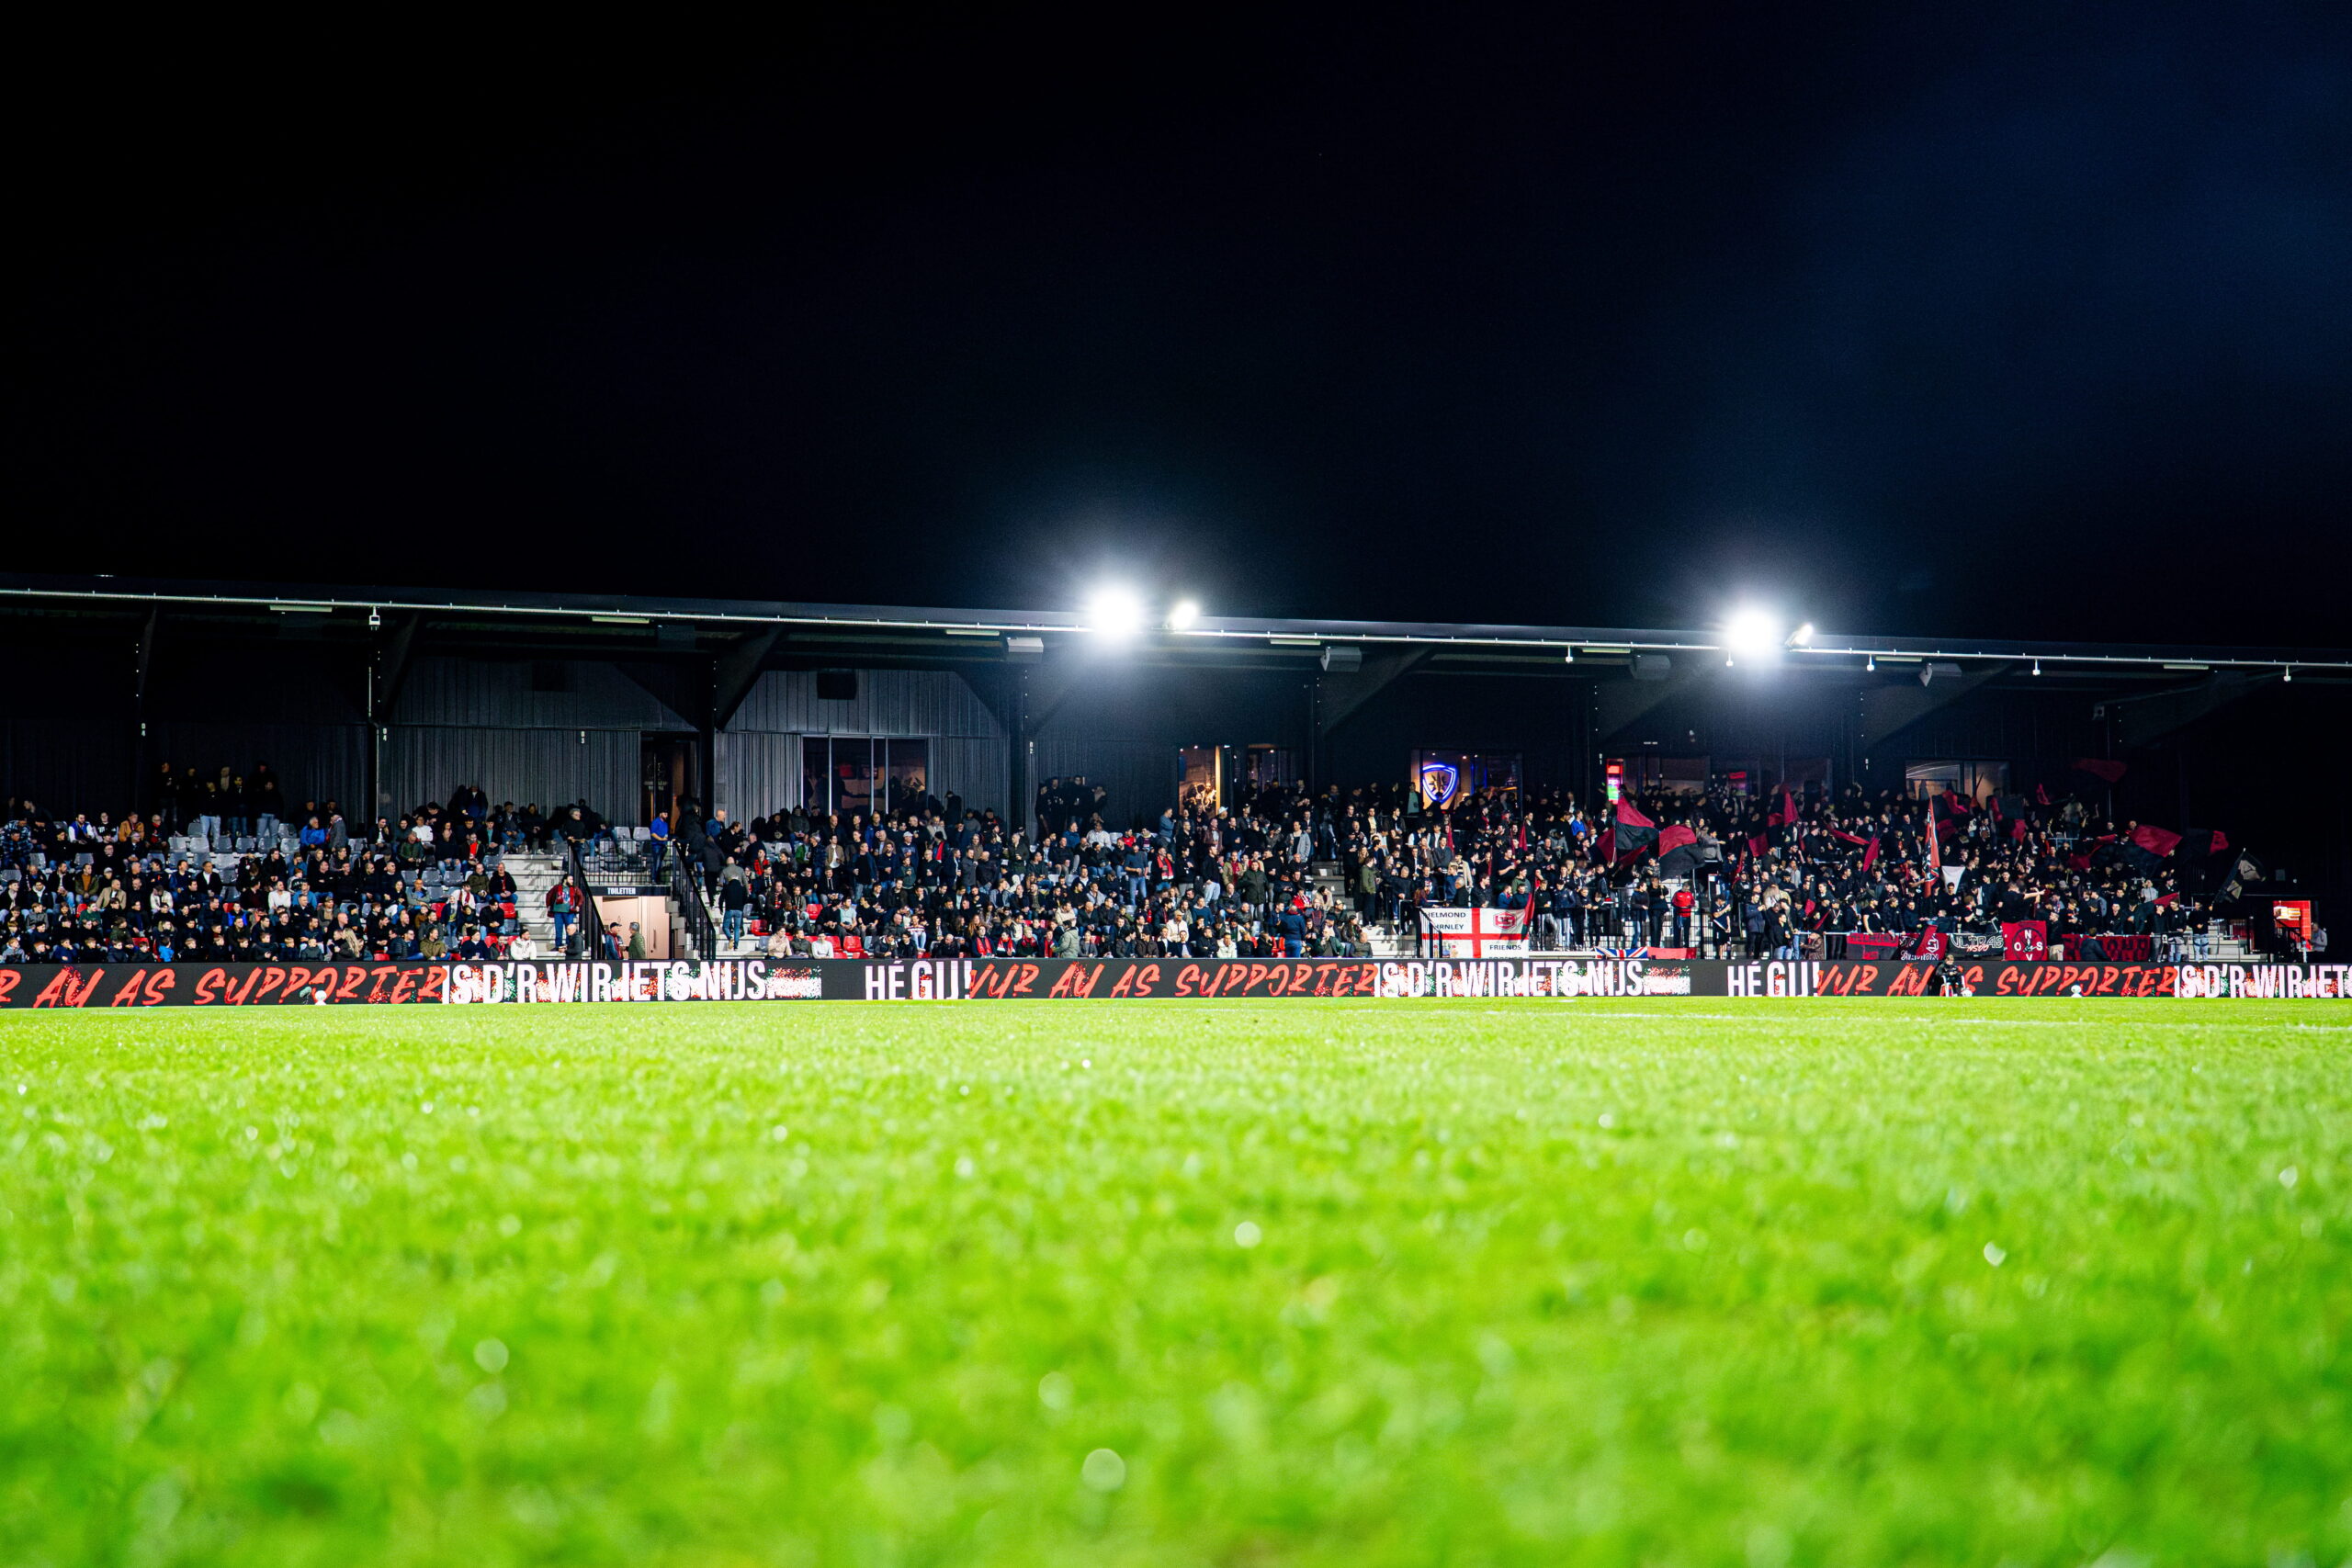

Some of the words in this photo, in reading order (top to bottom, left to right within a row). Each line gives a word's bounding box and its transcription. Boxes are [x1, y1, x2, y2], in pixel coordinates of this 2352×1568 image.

[112, 968, 175, 1007] AS
[193, 965, 448, 1007] SUPPORTER
[441, 964, 474, 1004] IS
[482, 962, 537, 1003] D'R
[546, 963, 612, 1002] WIR
[865, 960, 906, 1000] HÉ
[910, 960, 973, 1000] GIJ!
[1110, 964, 1161, 998] AS
[1174, 964, 1379, 998] SUPPORTER
[1374, 962, 1401, 998] IS
[1408, 961, 1453, 997] D'R
[1459, 962, 1517, 997] WIR
[1727, 962, 1763, 998] HÉ
[1767, 962, 1820, 997] GIJ!
[1996, 965, 2178, 998] SUPPORTER
[2174, 965, 2197, 998] IS
[2205, 964, 2245, 998] D'R
[2253, 964, 2303, 998] WIR
